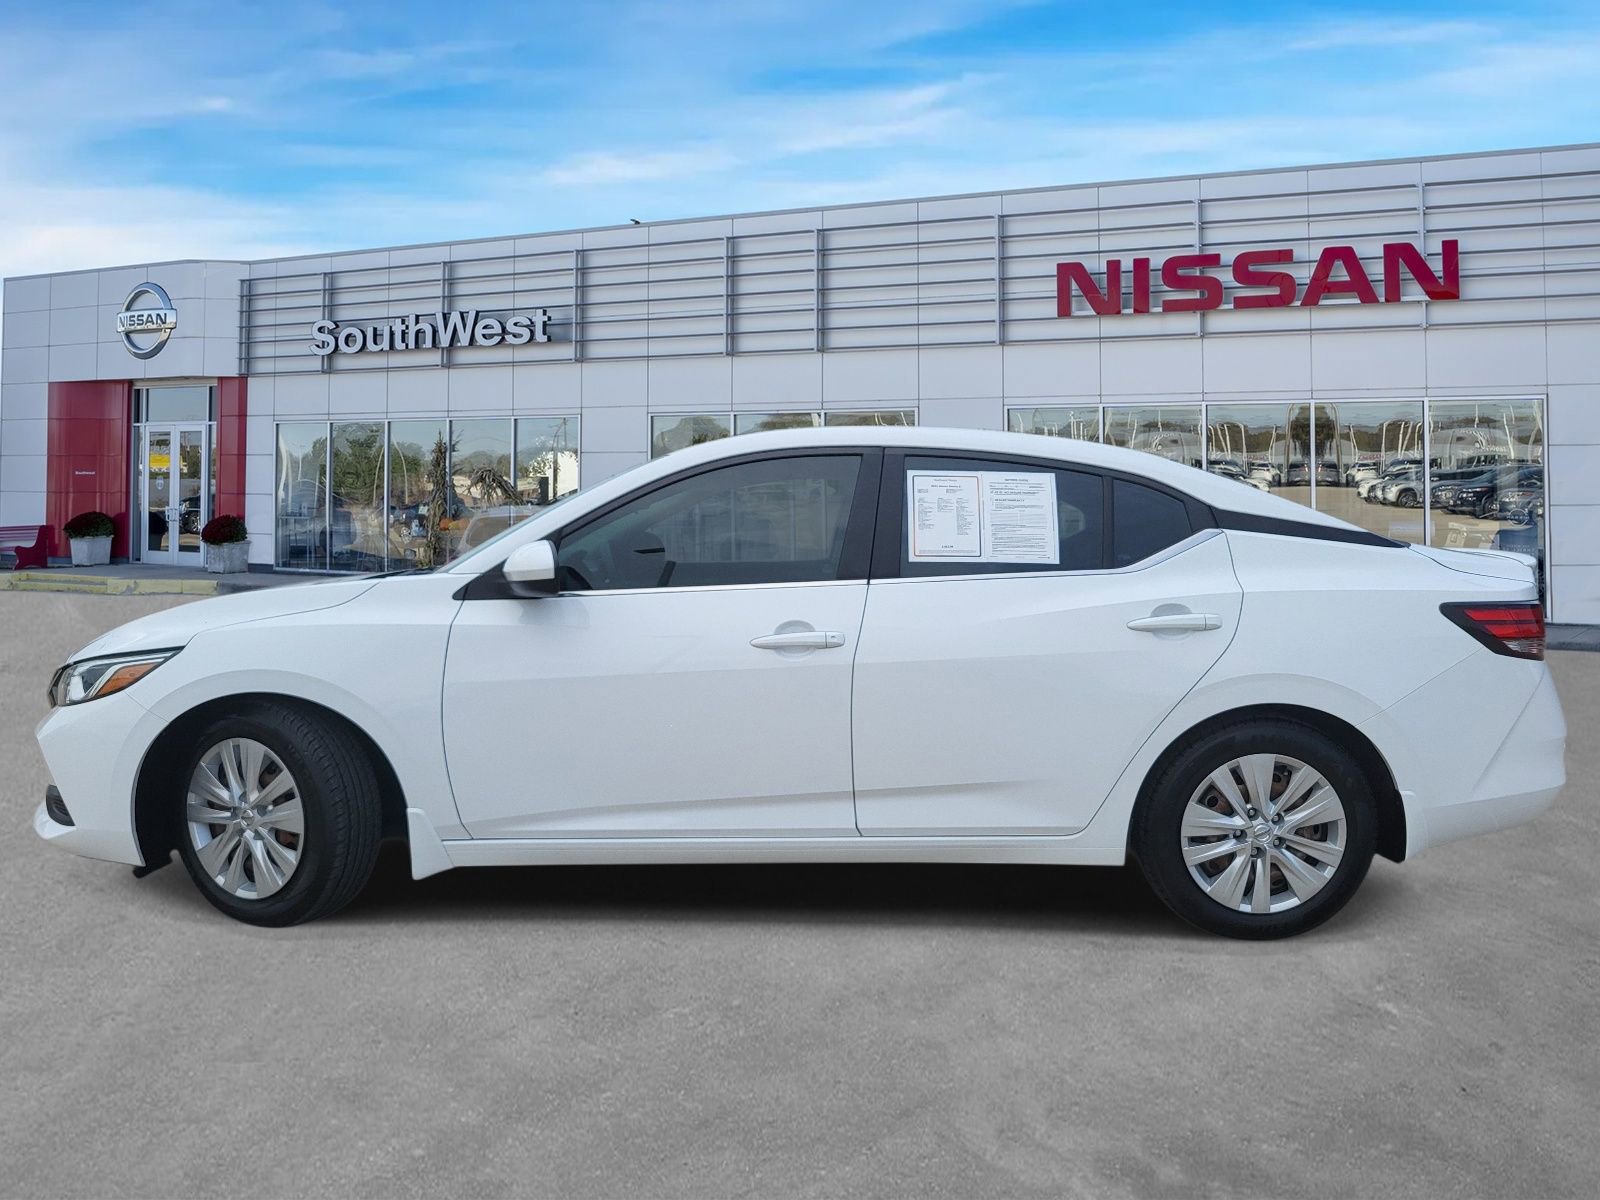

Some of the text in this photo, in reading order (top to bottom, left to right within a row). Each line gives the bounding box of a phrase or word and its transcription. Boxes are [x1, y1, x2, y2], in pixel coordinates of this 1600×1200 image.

[1056, 239, 1460, 318] NISSAN
[118, 313, 167, 328] NISSAN
[308, 308, 550, 356] SouthWest
